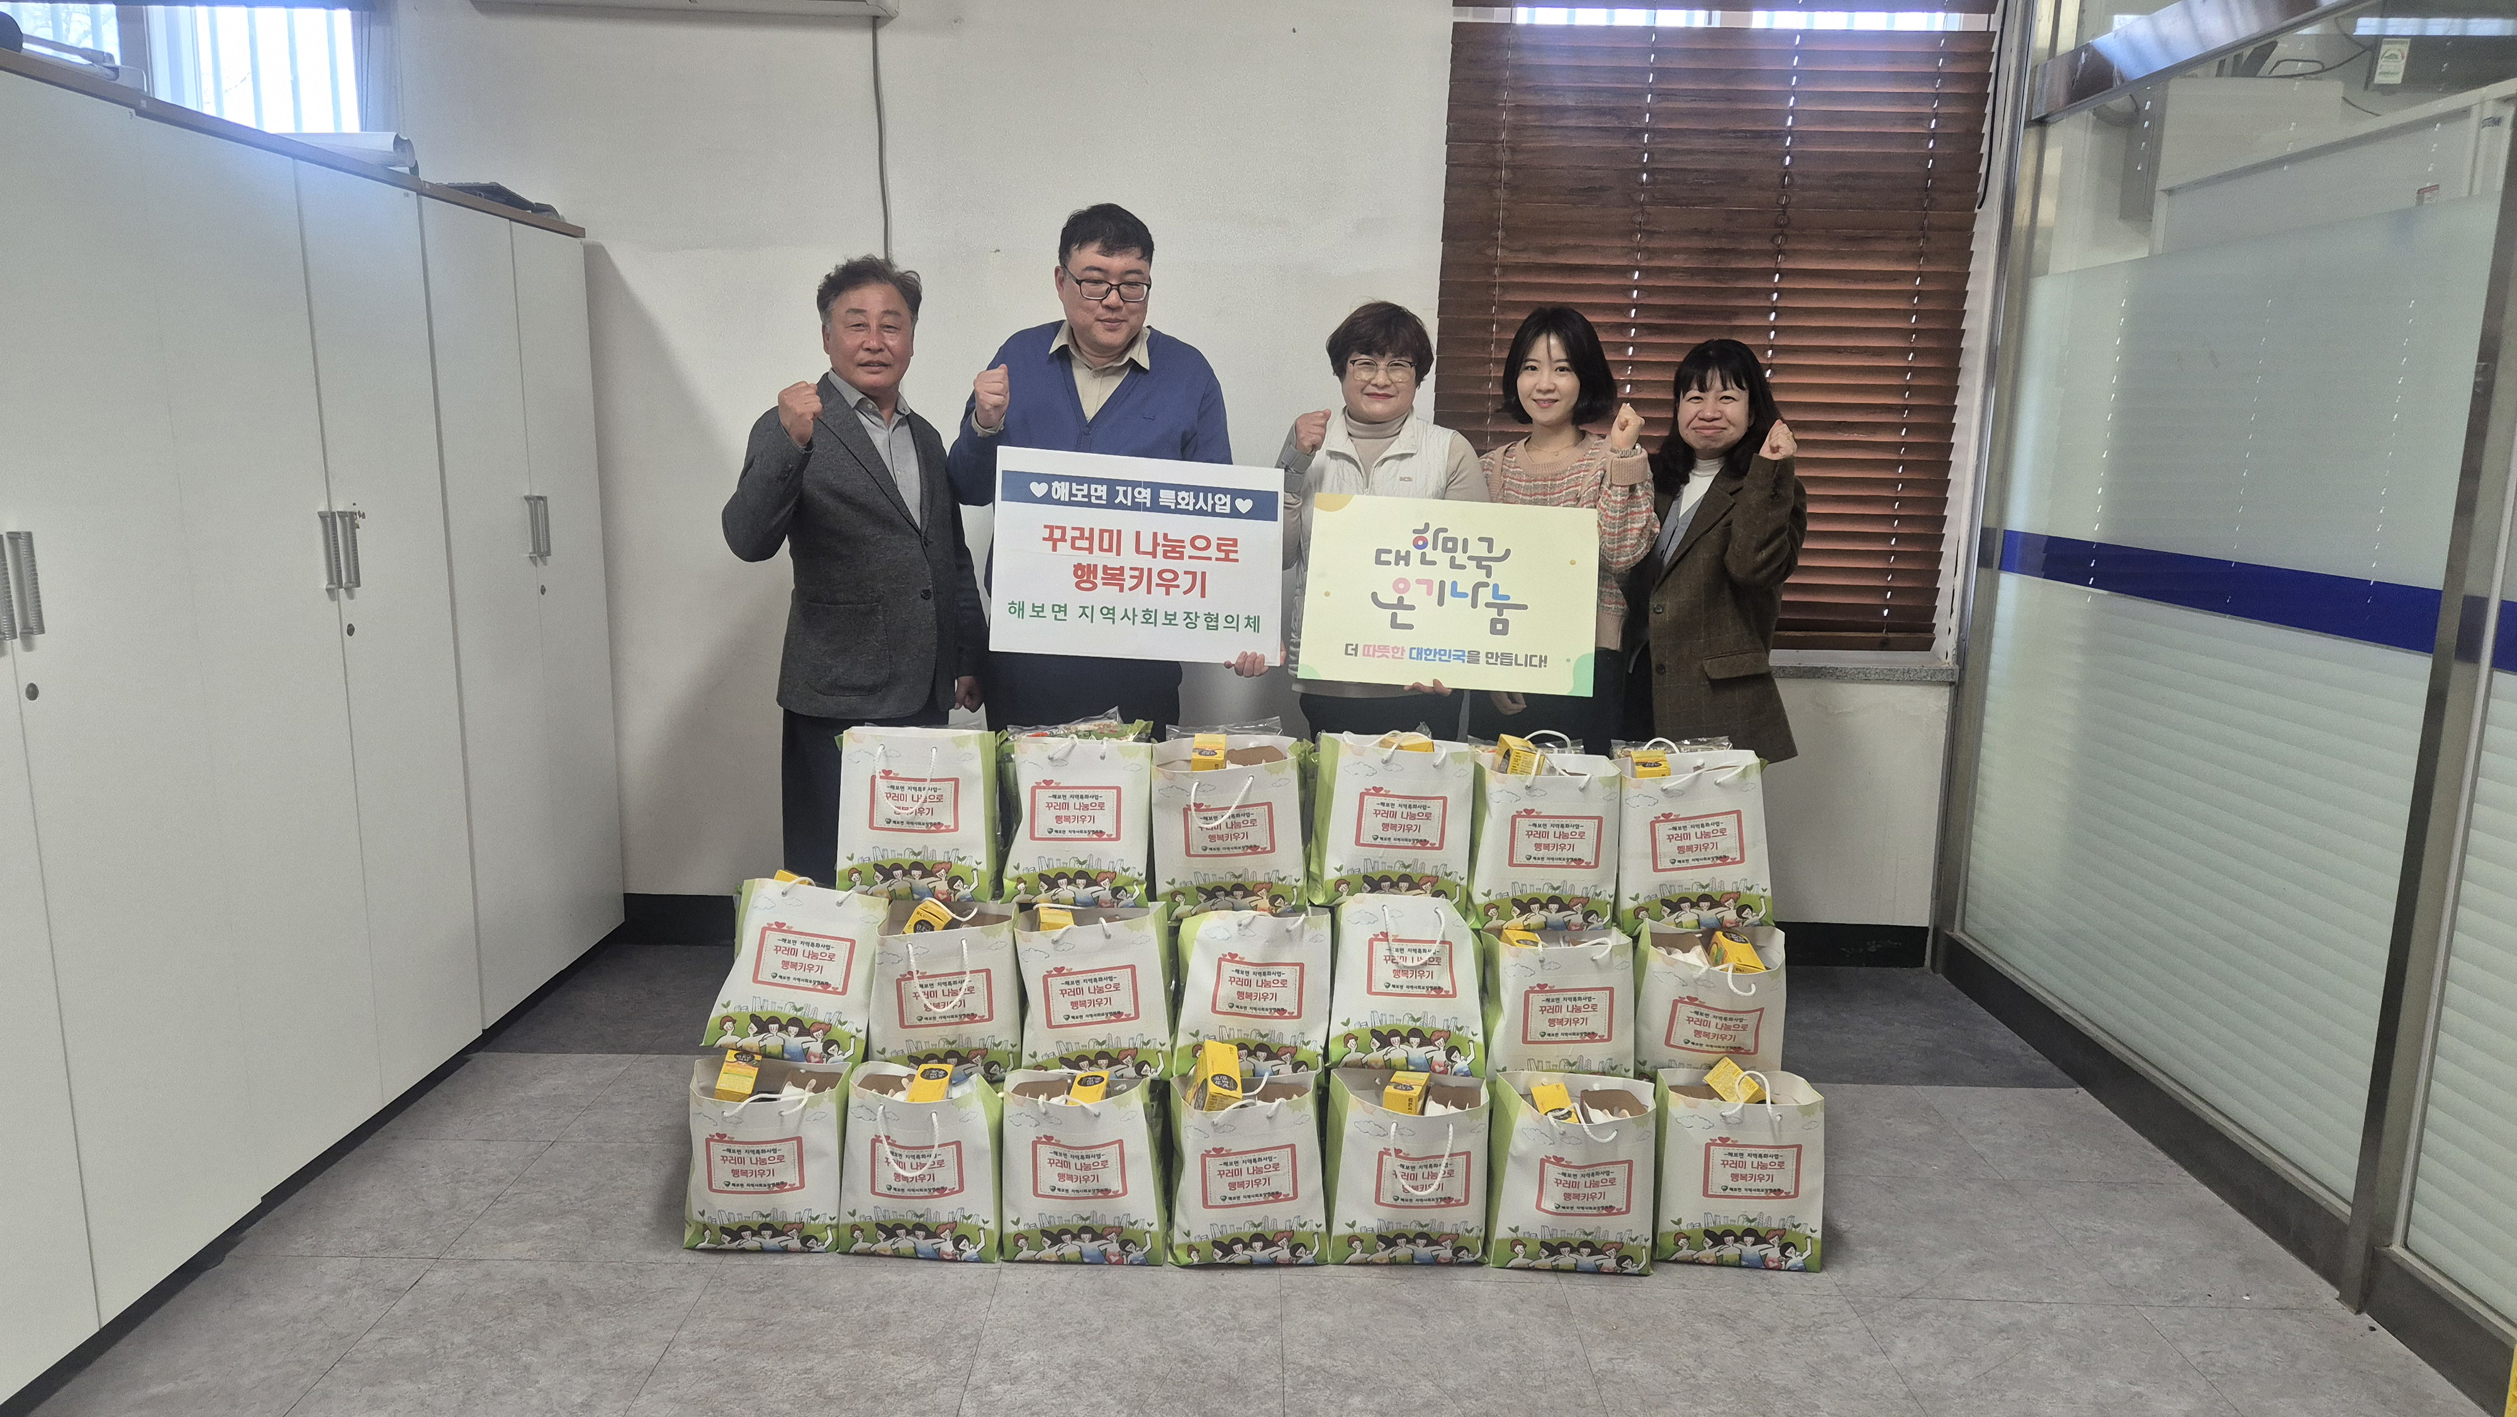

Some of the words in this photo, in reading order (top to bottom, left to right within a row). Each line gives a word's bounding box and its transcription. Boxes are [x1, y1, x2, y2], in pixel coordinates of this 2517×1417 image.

[1051, 481, 1107, 504] 해보면
[1114, 487, 1151, 507] 지역
[1158, 490, 1231, 514] 특화사업
[1042, 524, 1122, 556] 꾸러미
[1134, 530, 1239, 563] 나눔으로
[1374, 522, 1512, 579] 대한민국
[1072, 562, 1207, 599] 행복키우기
[1370, 577, 1529, 636] 온기나눔
[1007, 600, 1068, 621] 해보면
[1078, 604, 1261, 633] 지역사회보장협의체
[1344, 643, 1359, 657] 더
[1362, 644, 1406, 660] 따뜻한
[1408, 647, 1481, 665] 대한민국을
[1485, 651, 1548, 668] 만듭니다!
[1046, 802, 1069, 810] 꾸러미
[1074, 802, 1105, 810] 나눔으로
[1055, 815, 1095, 824] 행복키우기
[1373, 809, 1396, 819] 꾸러미
[1401, 810, 1432, 820] 나눔으로
[1226, 819, 1257, 829] 나눔으로
[1382, 823, 1420, 833] 행복키우기
[1208, 832, 1248, 842] 행복키우기
[1525, 830, 1549, 839] 꾸러미
[1554, 831, 1586, 840] 나눔으로
[1667, 833, 1691, 842] 꾸러미
[1695, 828, 1727, 839] 나눔으로
[1534, 843, 1574, 852] 행복키우기
[1677, 842, 1718, 854] 행복키우기
[773, 945, 798, 957] 꾸러미
[803, 950, 835, 962] 나눔으로
[781, 960, 823, 974] 행복키우기
[1392, 969, 1433, 979] 행복키우기
[1228, 976, 1252, 987] 꾸러미
[1256, 979, 1287, 988] 나눔으로
[1059, 989, 1084, 998] 꾸러미
[1088, 983, 1121, 994] 나눔으로
[1237, 990, 1277, 1002] 행복키우기
[1070, 997, 1112, 1008] 행복키우기
[1539, 1005, 1562, 1014] 꾸러미
[1566, 1003, 1598, 1013] 나눔으로
[1548, 1017, 1587, 1027] 행복키우기
[1686, 1016, 1711, 1027] 꾸러미
[1716, 1021, 1748, 1031] 나눔으로
[1694, 1030, 1736, 1042] 행복키우기
[721, 1155, 745, 1165] 꾸러미
[750, 1155, 785, 1165] 나눔으로
[1047, 1158, 1071, 1170] 꾸러미
[1075, 1159, 1109, 1171] 나눔으로
[1721, 1160, 1746, 1170] 꾸러미
[1751, 1160, 1785, 1170] 나눔으로
[731, 1169, 774, 1178] 행복키우기
[1217, 1170, 1242, 1178] 꾸러미
[1247, 1163, 1280, 1175] 나눔으로
[1057, 1172, 1099, 1183] 행복키우기
[1730, 1173, 1773, 1182] 행복키우기
[1228, 1177, 1270, 1190] 행복키우기
[1555, 1178, 1580, 1189] 꾸러미
[1584, 1178, 1616, 1188] 나눔으로
[1563, 1192, 1605, 1201] 행복키우기
